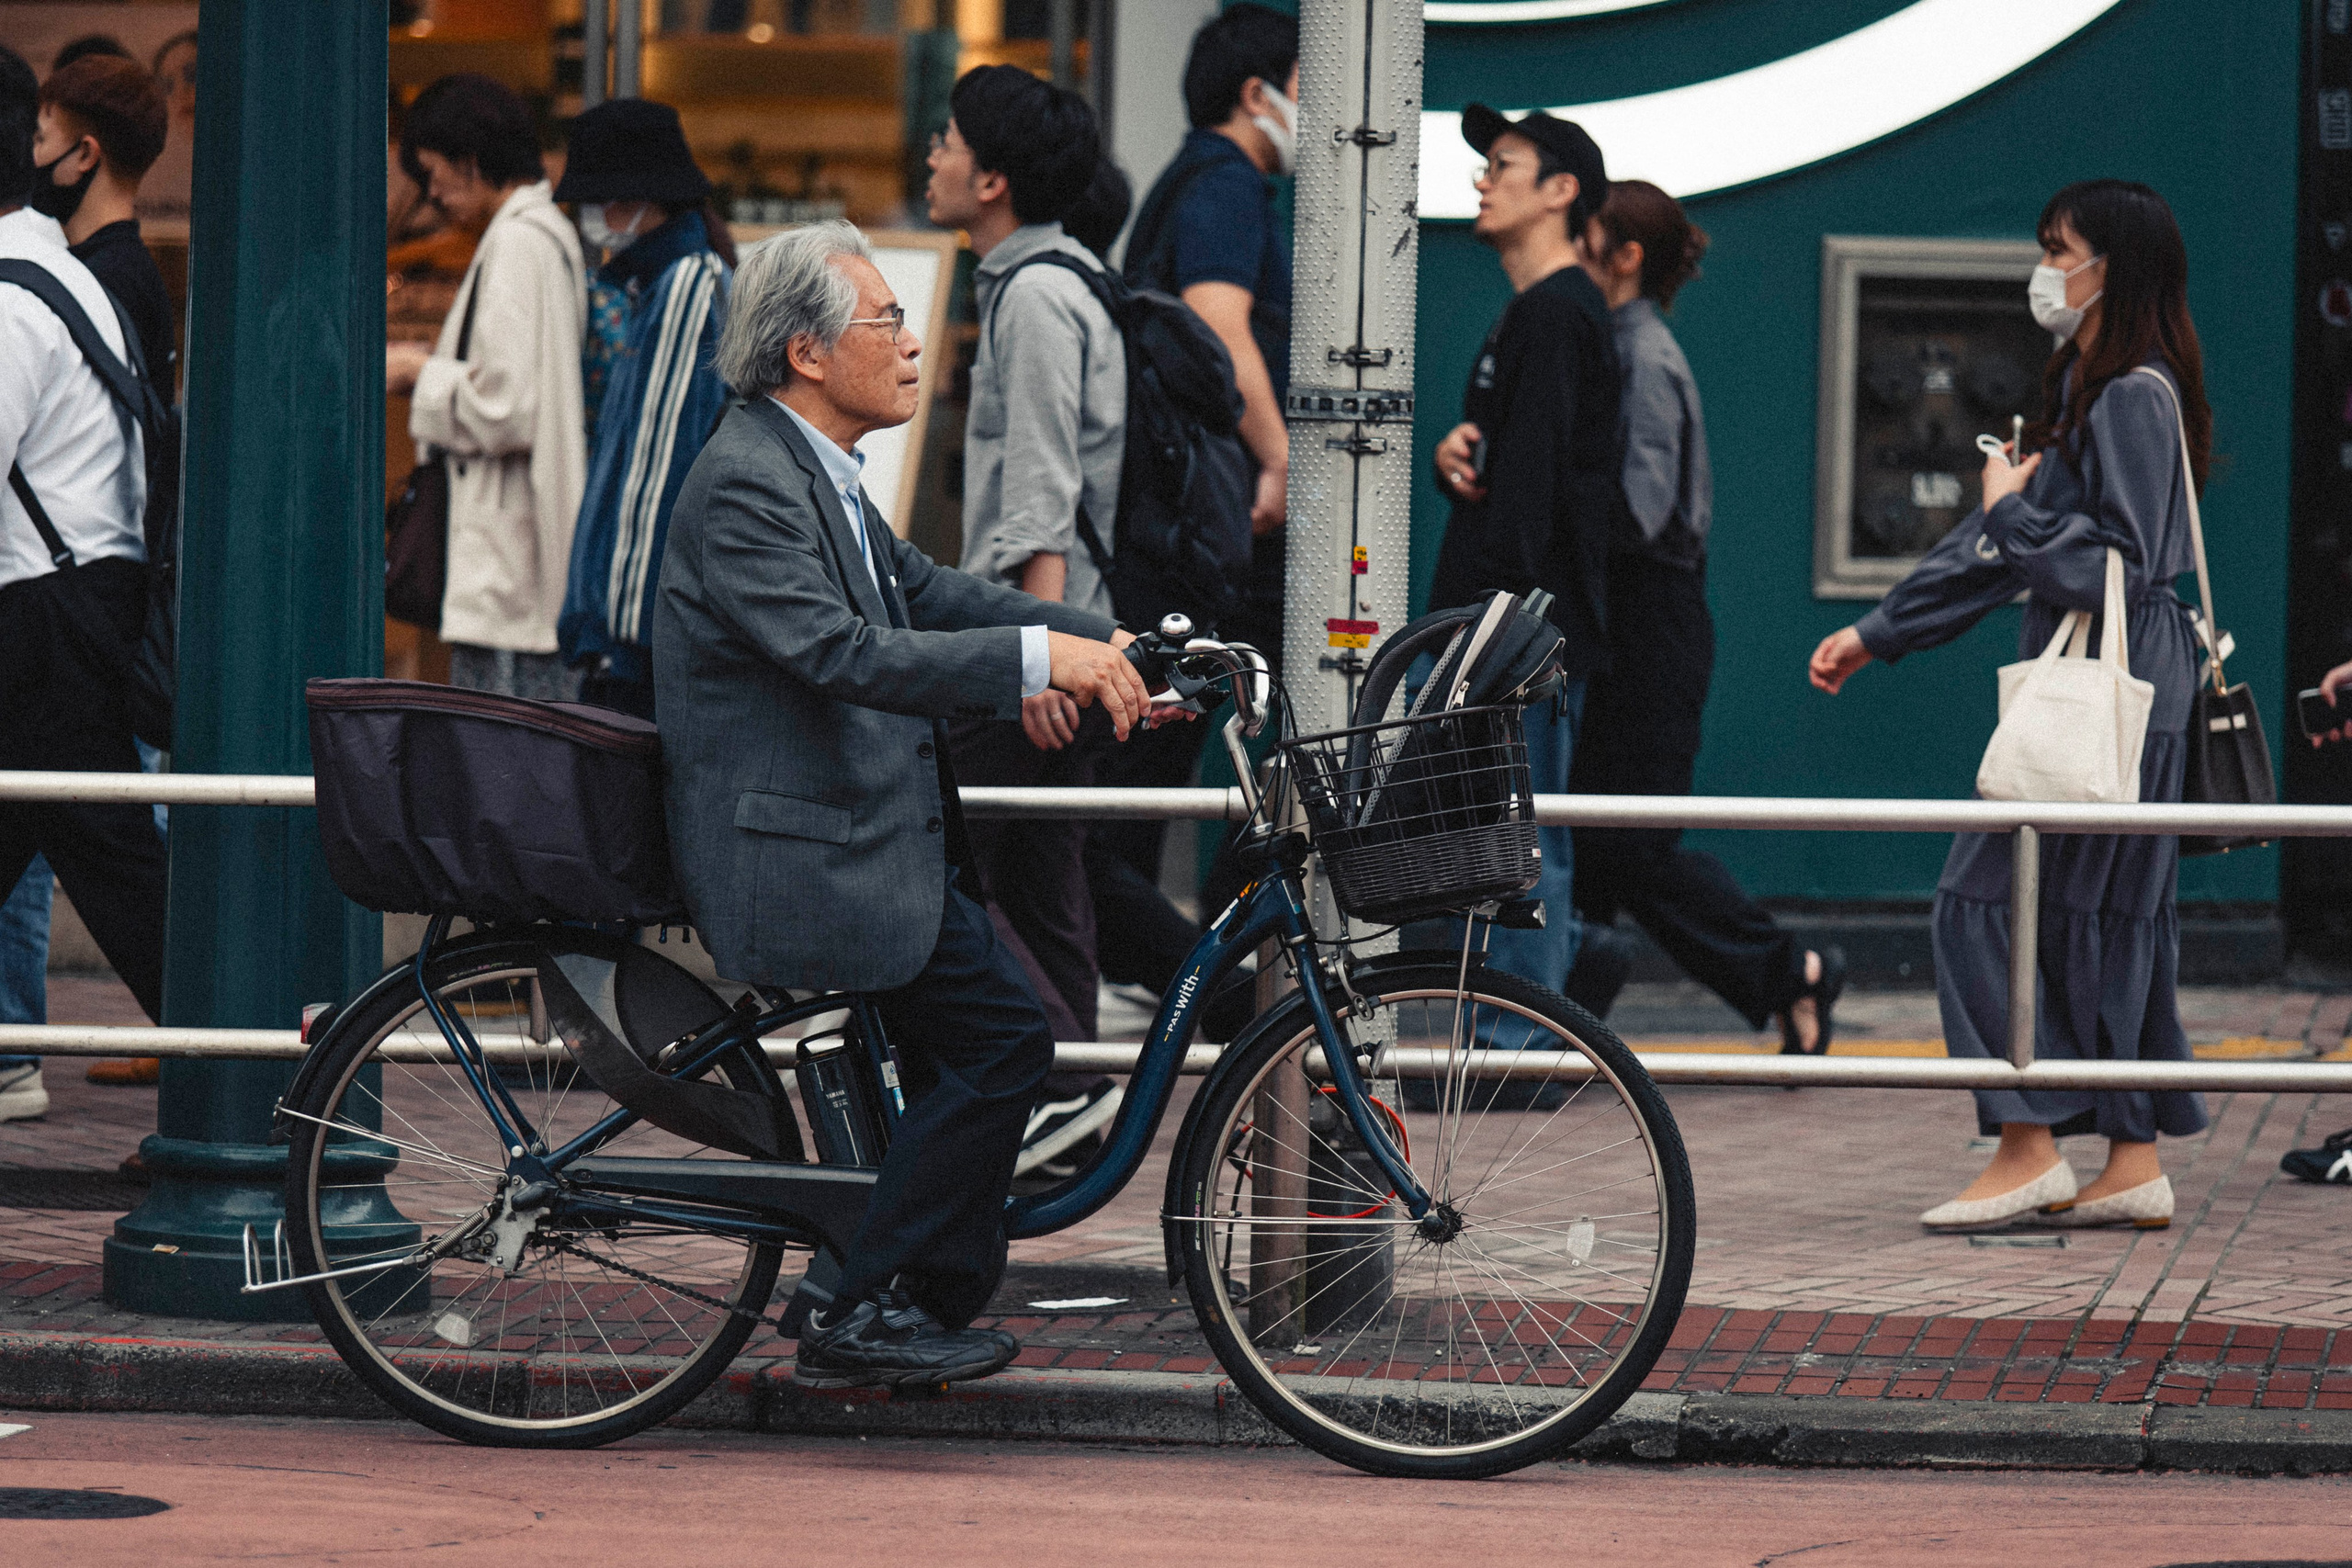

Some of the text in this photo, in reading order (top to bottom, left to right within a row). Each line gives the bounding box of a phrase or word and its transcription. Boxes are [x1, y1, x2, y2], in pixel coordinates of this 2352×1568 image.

[1168, 976, 1199, 1032] PAS with
[826, 1089, 845, 1100] YAMAHA
